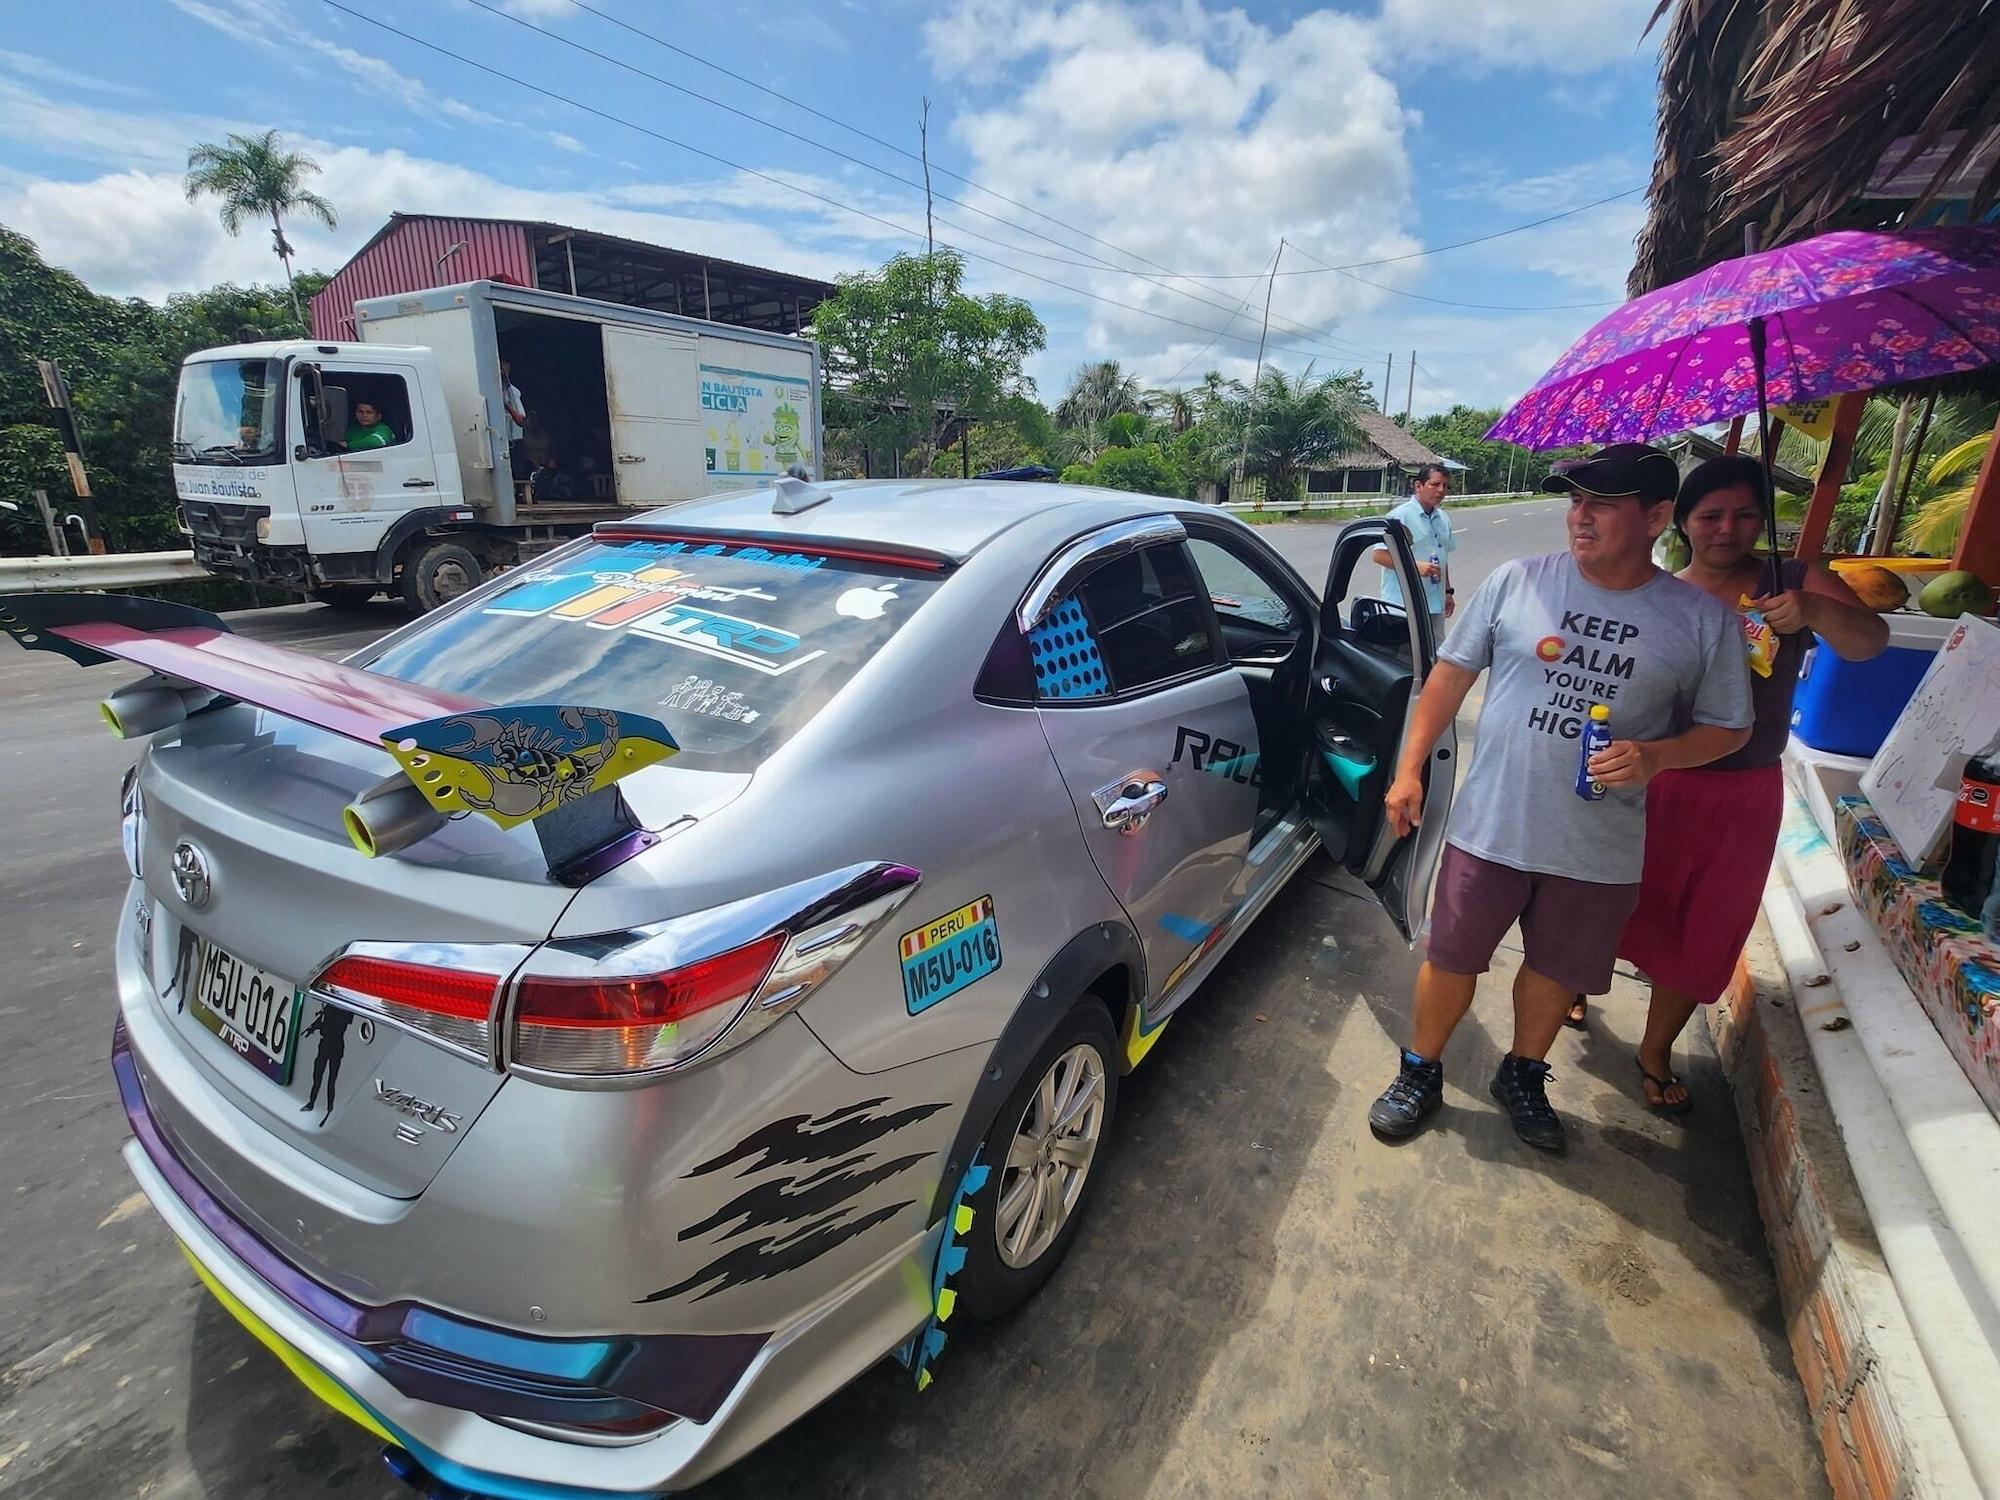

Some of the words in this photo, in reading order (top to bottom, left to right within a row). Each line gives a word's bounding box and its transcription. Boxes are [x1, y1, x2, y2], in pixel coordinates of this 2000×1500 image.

[702, 394, 747, 412] CICLA
[713, 382, 763, 398] BAUTISTA
[189, 480, 211, 495] Juan
[212, 480, 256, 497] Bautista
[248, 468, 267, 481] de
[660, 606, 801, 654] TRD
[1560, 610, 1640, 646] KEEP
[1536, 636, 1636, 681] CALM
[1543, 668, 1619, 700] YOU'RE
[1527, 707, 1583, 740] HIG
[930, 911, 965, 944] PERÚ
[908, 928, 997, 1003] M5U-016
[200, 942, 290, 1055] M5U-016
[374, 1077, 464, 1134] YARIS
[394, 1121, 425, 1146] E
